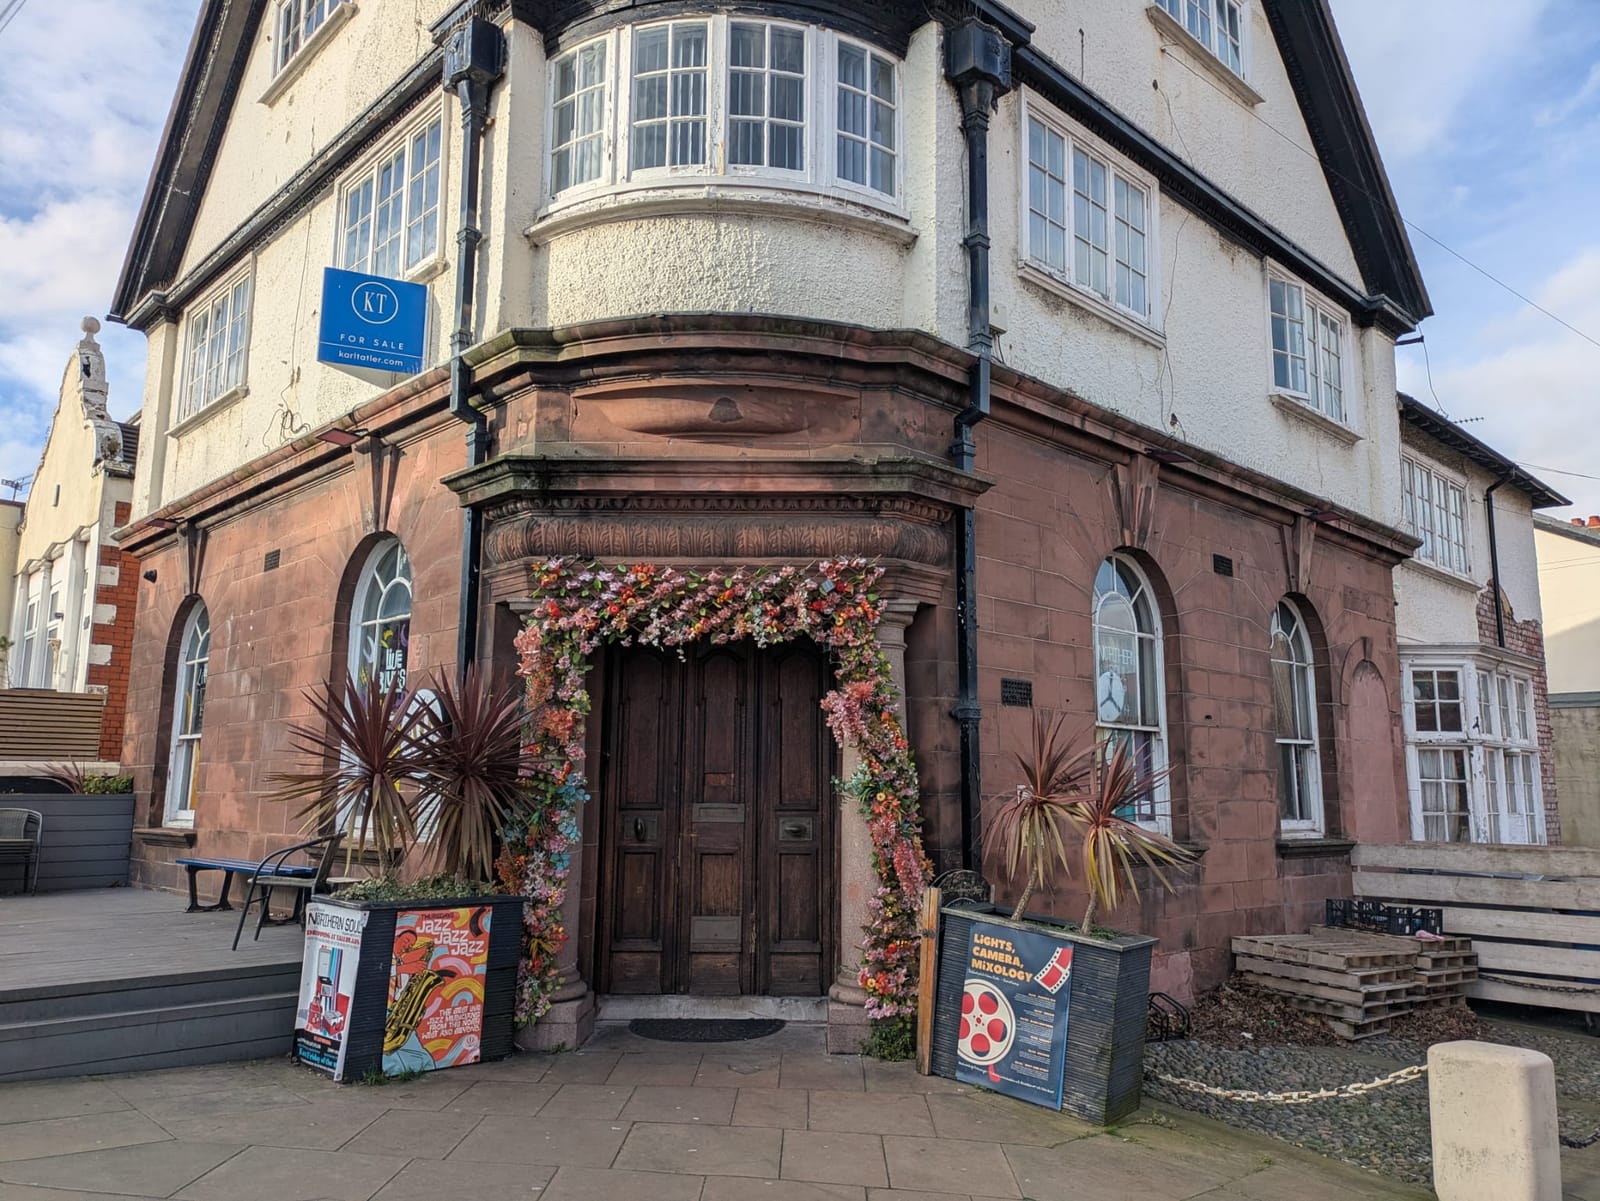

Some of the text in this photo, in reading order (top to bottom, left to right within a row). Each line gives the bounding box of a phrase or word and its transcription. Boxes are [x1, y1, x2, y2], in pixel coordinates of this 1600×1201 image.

[364, 291, 387, 314] KT
[340, 334, 404, 350] FOR SALE
[972, 945, 1024, 969] CAMERA,
